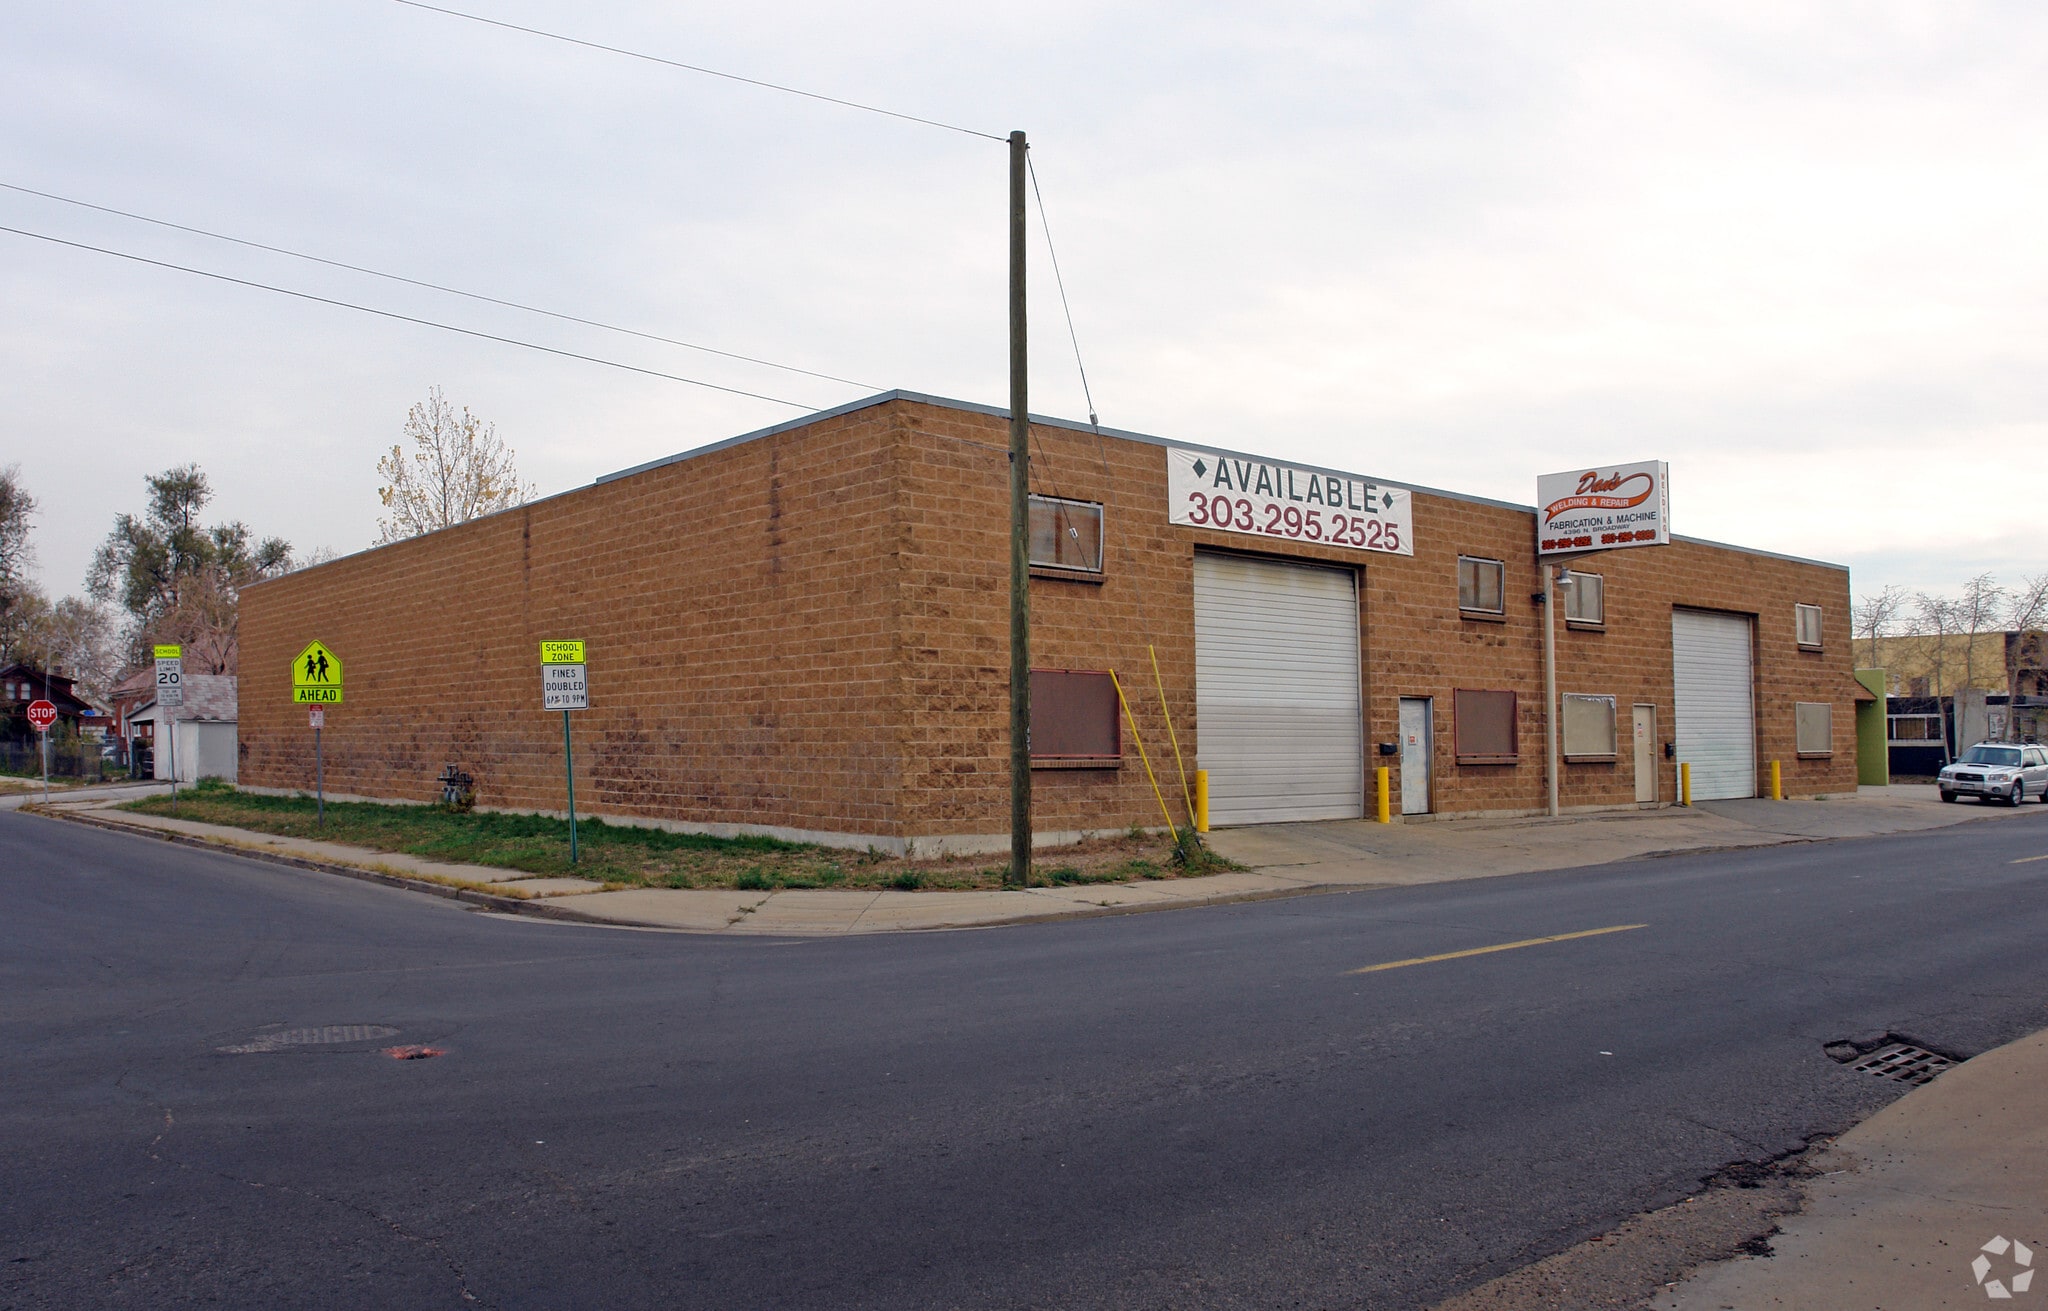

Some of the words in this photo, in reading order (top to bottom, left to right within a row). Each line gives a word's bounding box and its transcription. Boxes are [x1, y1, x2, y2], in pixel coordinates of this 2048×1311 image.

[1213, 457, 1379, 514] AVAILABLE
[1550, 498, 1589, 513] WELDING
[1591, 498, 1597, 506] &
[1600, 498, 1630, 507] REPAIR
[1188, 492, 1400, 551] 303.295.2525
[1549, 517, 1603, 531] FABRICATION
[1606, 516, 1613, 525] &
[1616, 511, 1657, 524] MACHINE
[1592, 523, 1631, 533] BROADWAY
[546, 643, 580, 651] SCHOOL
[552, 653, 575, 661] ZONE
[158, 672, 179, 684] 20
[552, 669, 576, 678] FINES
[546, 681, 584, 691] DOUBLED
[299, 689, 337, 701] AHEAD
[562, 694, 570, 704] TO
[572, 694, 586, 704] 9PM
[30, 708, 56, 718] STOP
